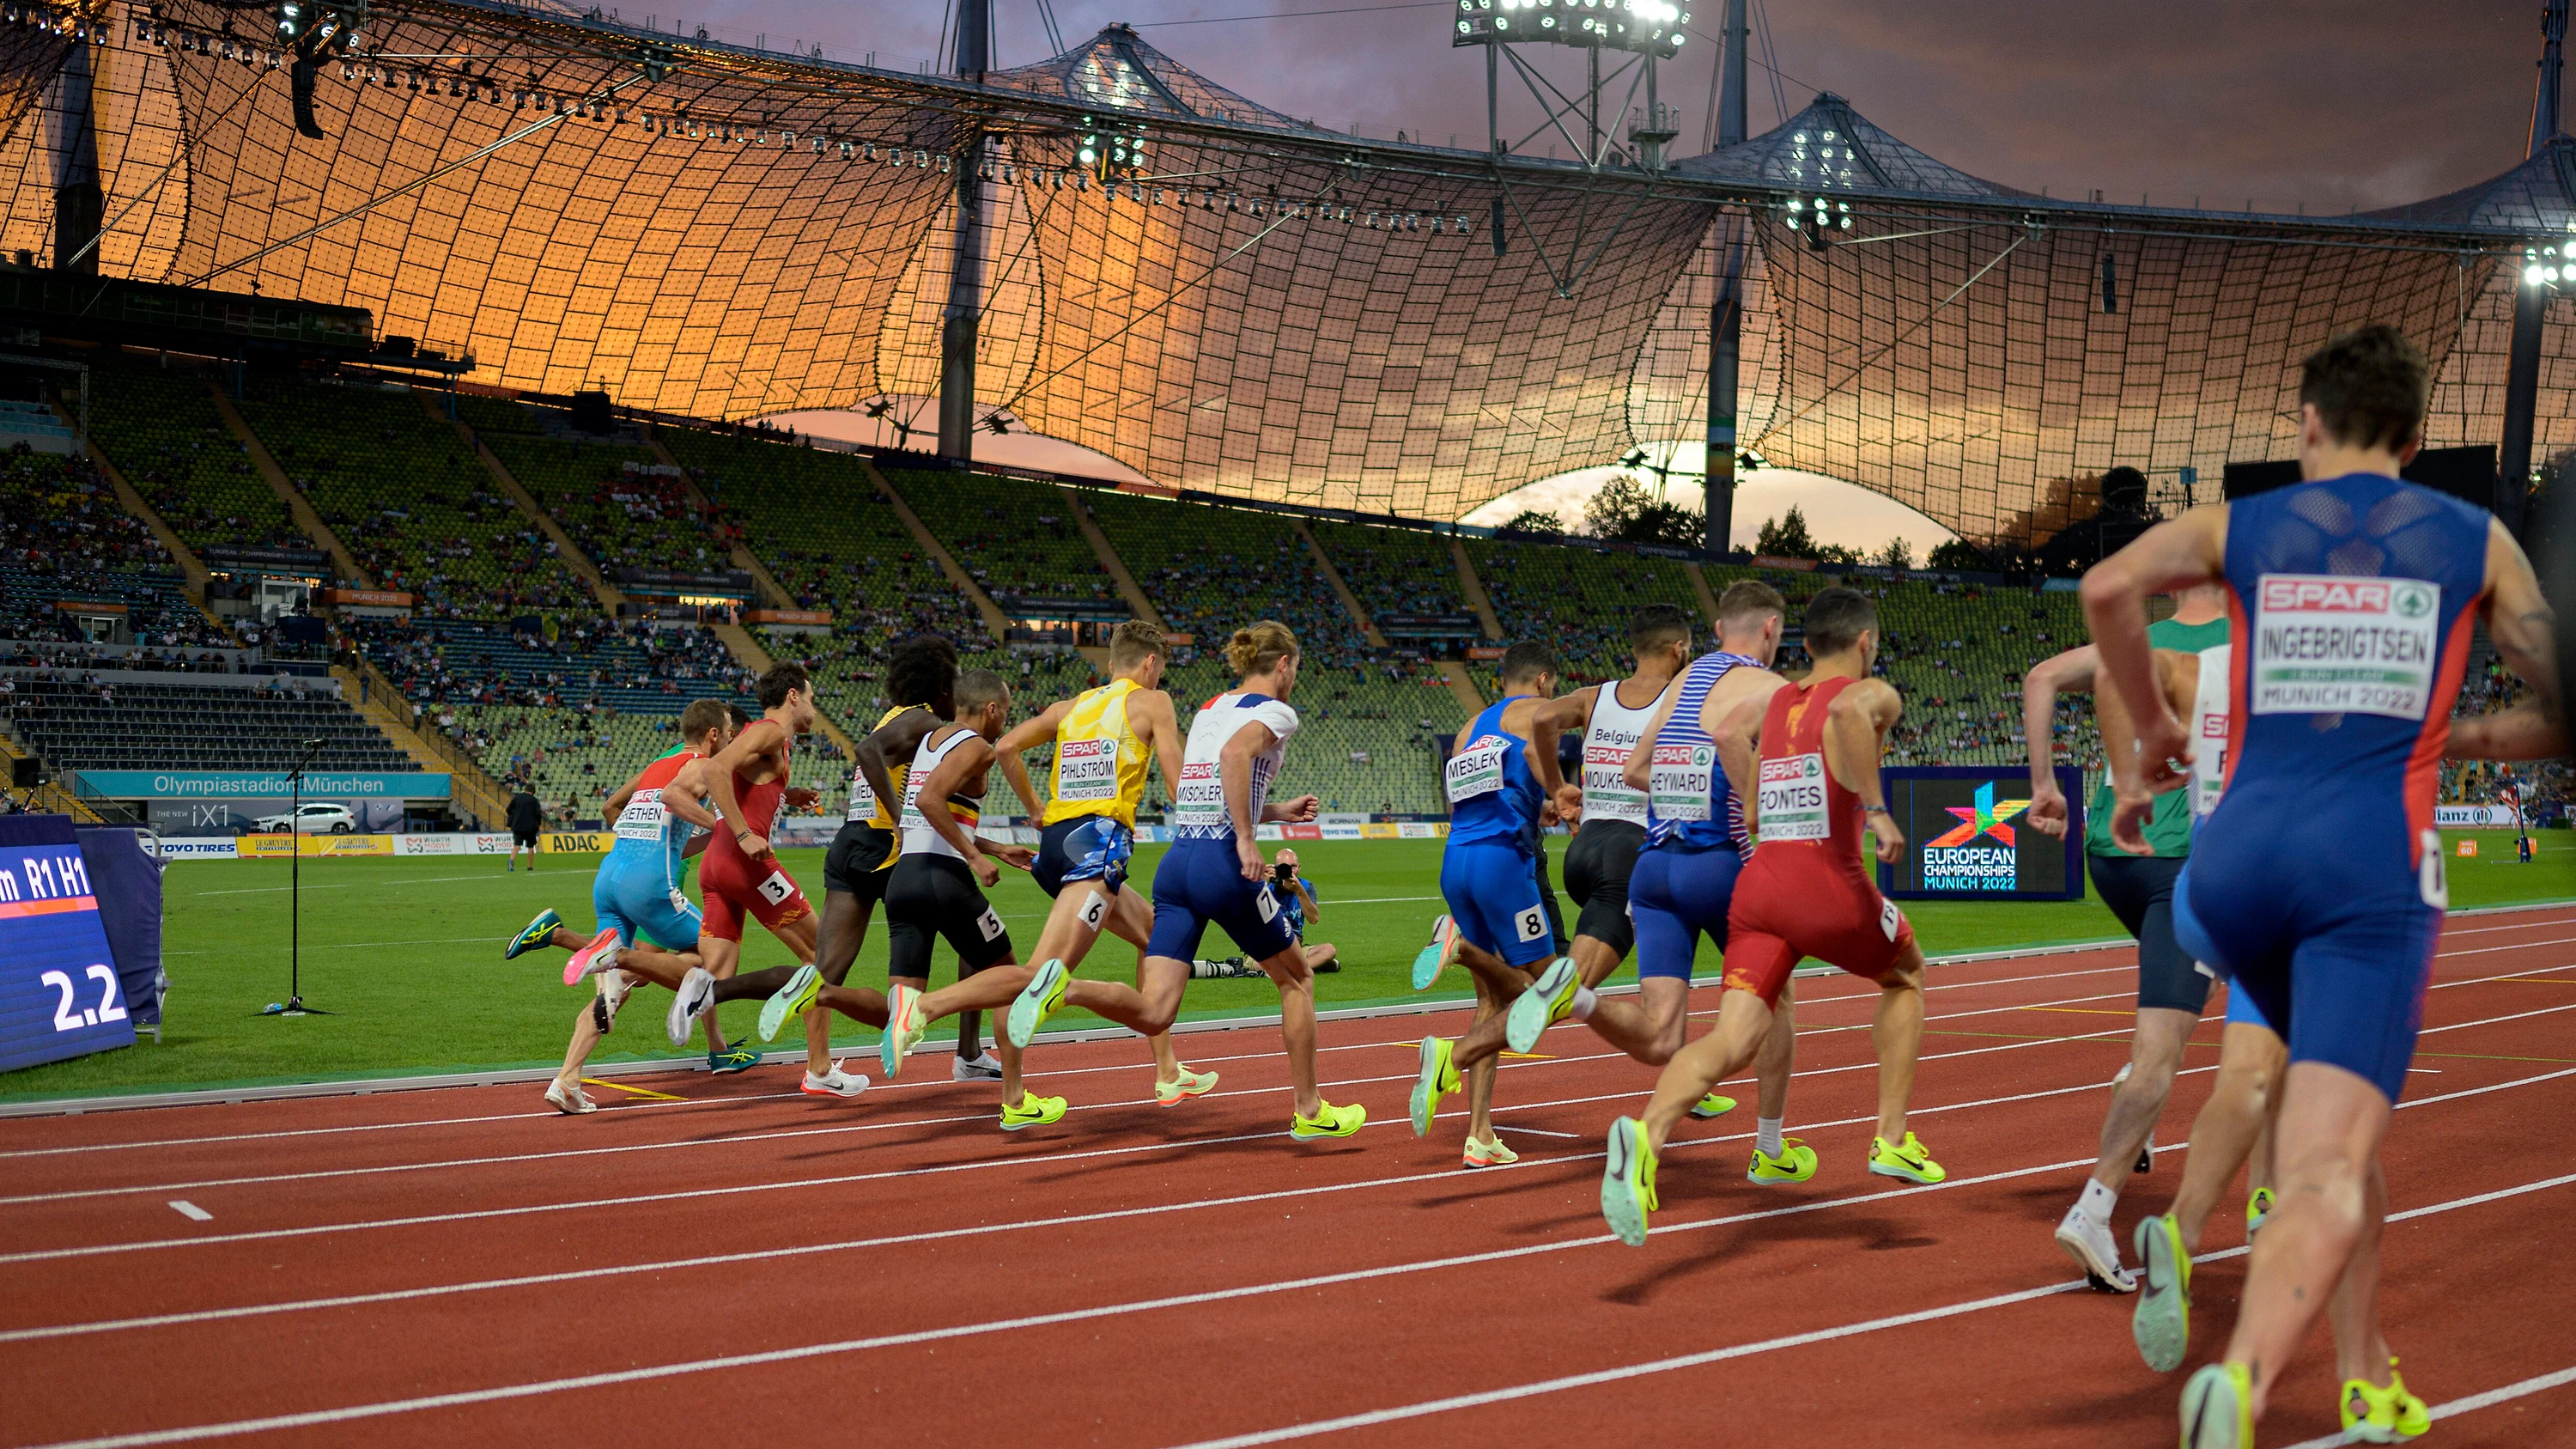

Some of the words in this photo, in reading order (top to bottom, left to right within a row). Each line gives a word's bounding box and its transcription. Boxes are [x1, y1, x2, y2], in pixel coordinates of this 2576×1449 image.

[209, 548, 238, 557] EUROPEAN
[246, 551, 286, 559] CHAMPIONSHIPS
[1564, 538, 1600, 549] EUROPEAN
[1637, 546, 1689, 558] CHAMPIONSHIPS
[1759, 557, 1788, 568] MUNICH
[1790, 561, 1808, 569] 2022
[352, 593, 379, 602] MUNICH
[380, 594, 398, 603] 2022
[2265, 583, 2388, 612] SPAR
[777, 612, 800, 621] MUNICH
[2262, 626, 2428, 664] INGEBRIGTSEN
[2263, 687, 2352, 708] MUNICH
[2359, 688, 2416, 710] 2022
[1063, 742, 1099, 757] SPAR
[1653, 748, 1690, 763] SPAR
[1060, 758, 1114, 779] PIHLSTRÖM
[1182, 764, 1212, 778] SPAR
[1449, 751, 1499, 779] MESLEK
[1763, 760, 1802, 780] SPAR
[155, 776, 296, 795] Olympiastadion
[303, 776, 383, 792] München
[1651, 772, 1707, 792] HEYWARD
[1060, 789, 1091, 800] MUNICH
[1093, 788, 1115, 797] 2022
[1178, 785, 1222, 801] MISCHLER
[1759, 786, 1821, 813] FONTES
[857, 809, 875, 818] 2022
[1587, 801, 1615, 812] MUNICH
[1618, 803, 1643, 813] 2022
[1680, 807, 1704, 818] 2022
[191, 805, 228, 827] iX1
[1202, 813, 1222, 823] 2022
[640, 830, 658, 838] 2022
[1796, 824, 1823, 836] 2022
[553, 835, 600, 852] ADAC
[1924, 849, 2015, 865] EUROPEAN
[23, 857, 58, 898] R1
[56, 856, 90, 896] H1
[1924, 865, 2015, 877] CHAMPIONSHIPS
[768, 880, 786, 898] 3
[1924, 877, 1978, 890] MUNICH
[1982, 877, 2015, 890] 2022
[1260, 891, 1273, 915] 7
[1088, 903, 1103, 923] 6
[987, 913, 999, 935] 5
[1525, 913, 1541, 936] 8
[40, 964, 128, 1032] 2.2
